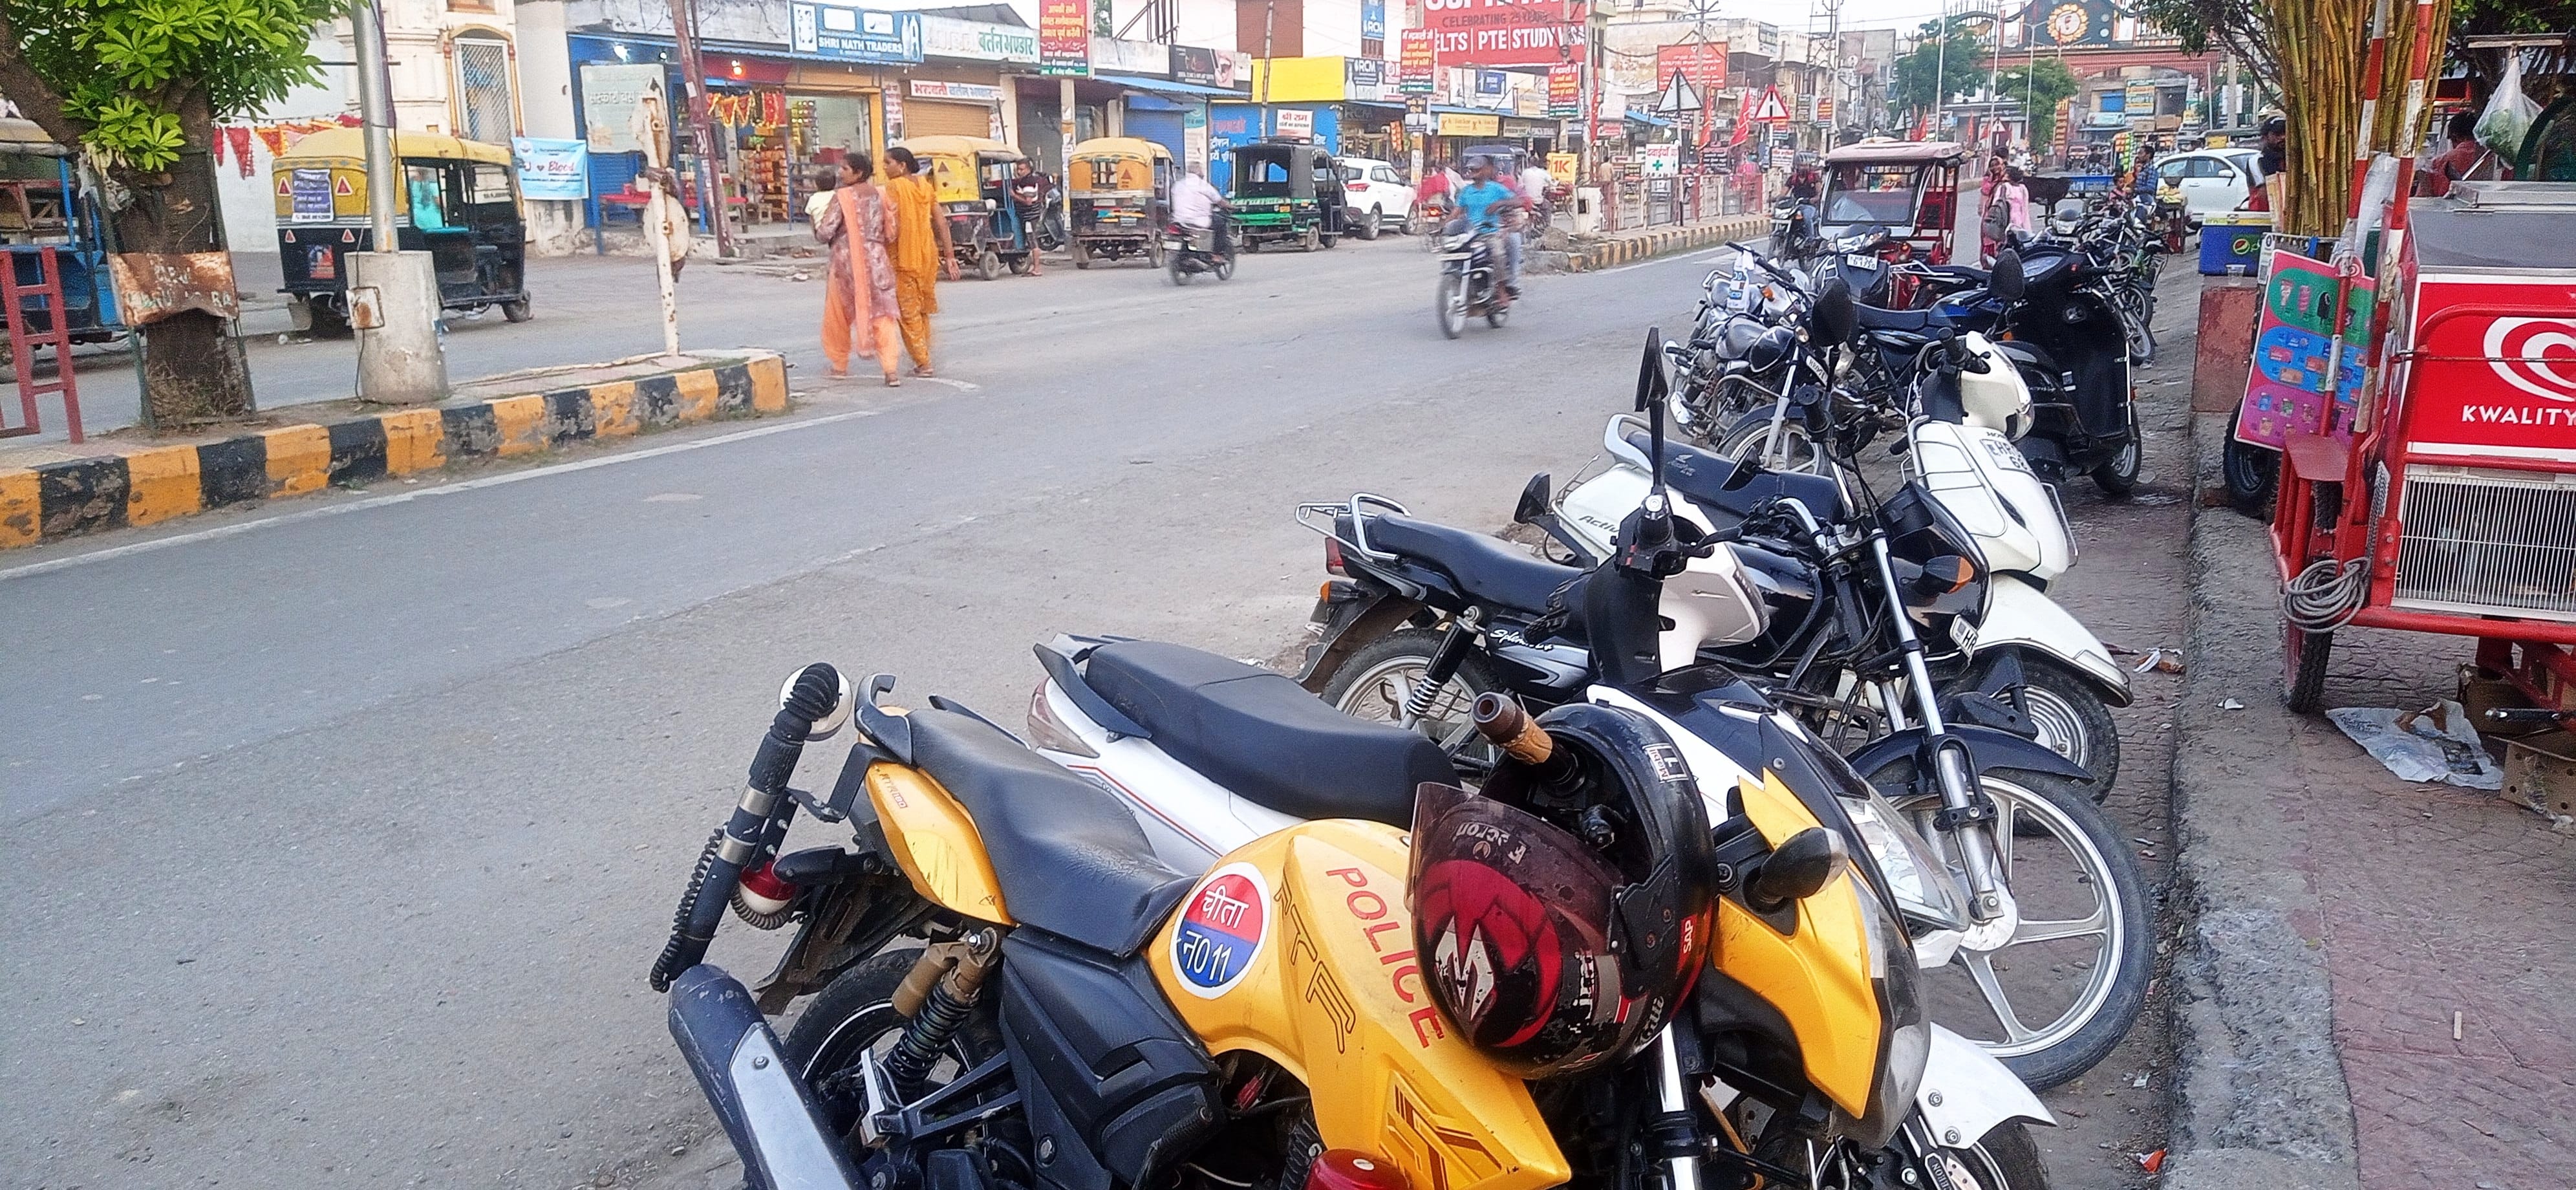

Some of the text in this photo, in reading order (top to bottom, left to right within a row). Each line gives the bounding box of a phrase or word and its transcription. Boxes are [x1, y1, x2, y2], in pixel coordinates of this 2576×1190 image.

[1442, 13, 1506, 28] CELEBRATING
[819, 37, 903, 54] SHRI NATH TRADERS
[1478, 29, 1507, 51] PTE
[1512, 27, 1555, 49] STUDY
[1359, 60, 1377, 73] RCM
[548, 161, 575, 172] Blood
[1554, 160, 1570, 173] 1K
[2462, 404, 2576, 426] KWALITY
[1649, 749, 1668, 778] Mobil
[1202, 884, 1250, 929] चीता
[1683, 920, 1694, 954] SAP
[1326, 867, 1445, 1049] POLICE
